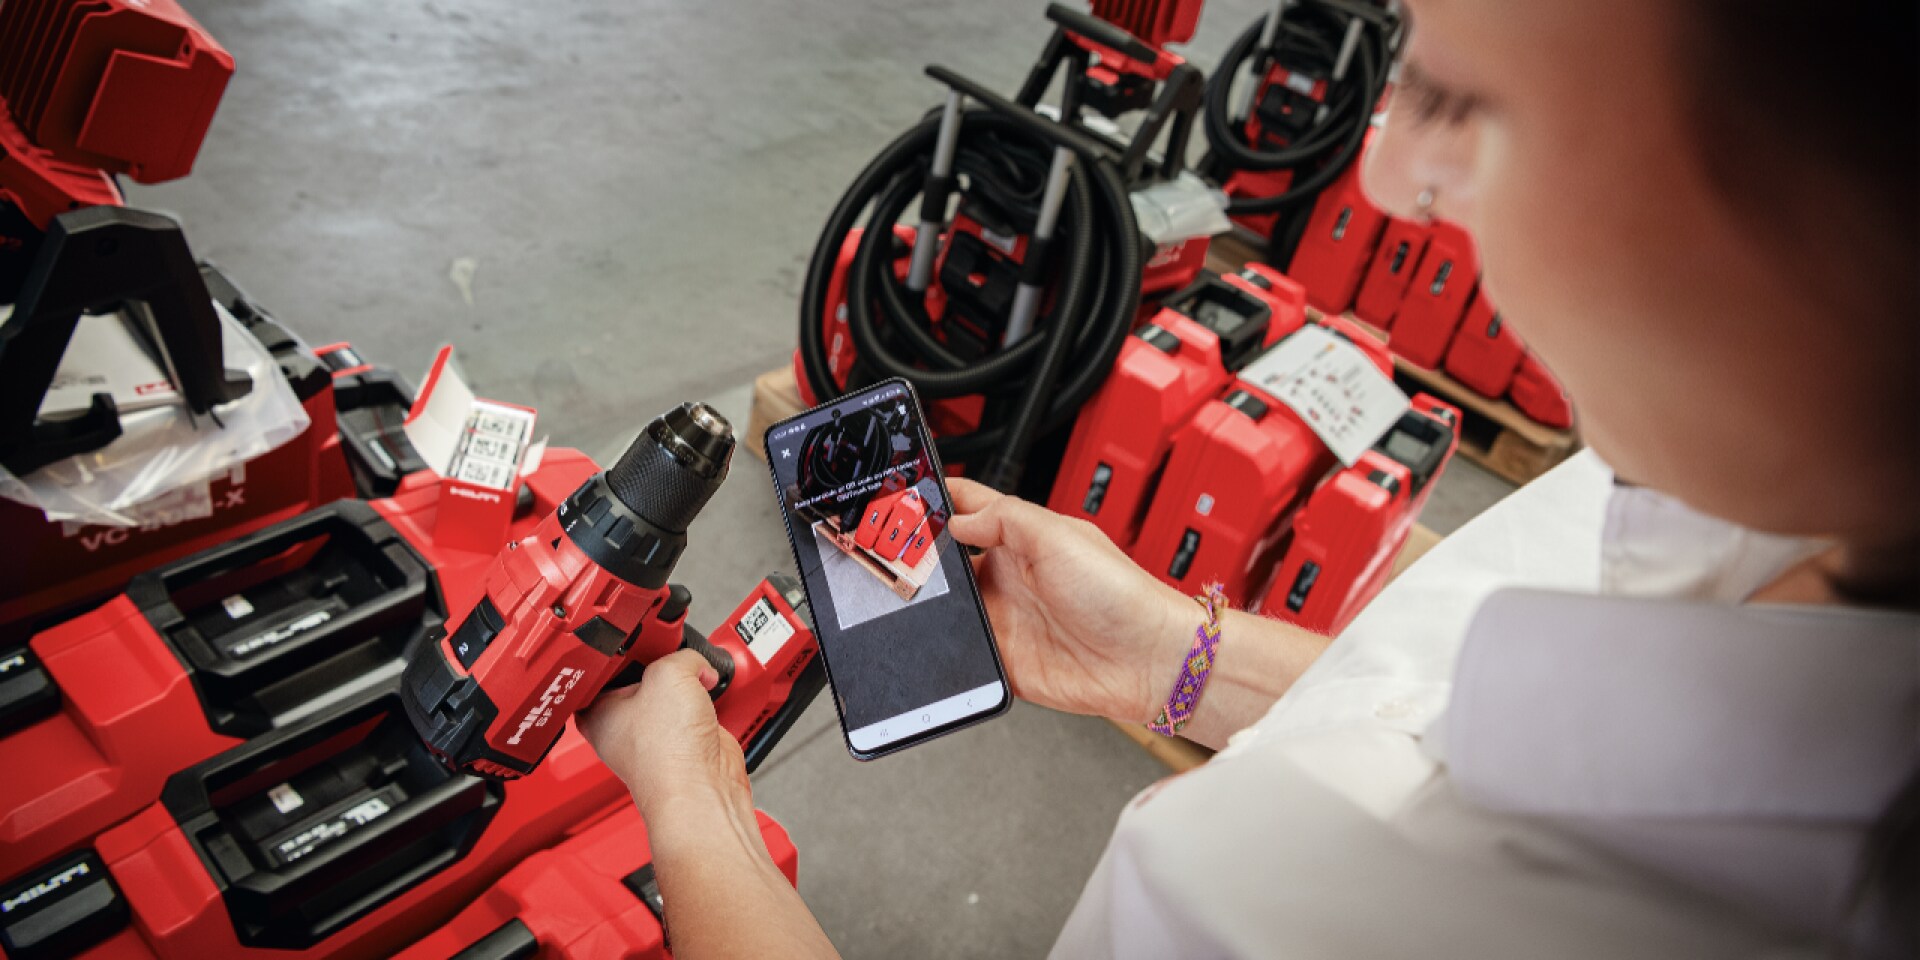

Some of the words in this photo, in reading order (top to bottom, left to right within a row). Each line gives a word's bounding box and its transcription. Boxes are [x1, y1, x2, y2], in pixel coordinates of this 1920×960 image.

[506, 666, 575, 745] HILTI
[535, 707, 553, 727] SF
[554, 669, 585, 704] 6-22
[1, 861, 91, 912] HILTI
